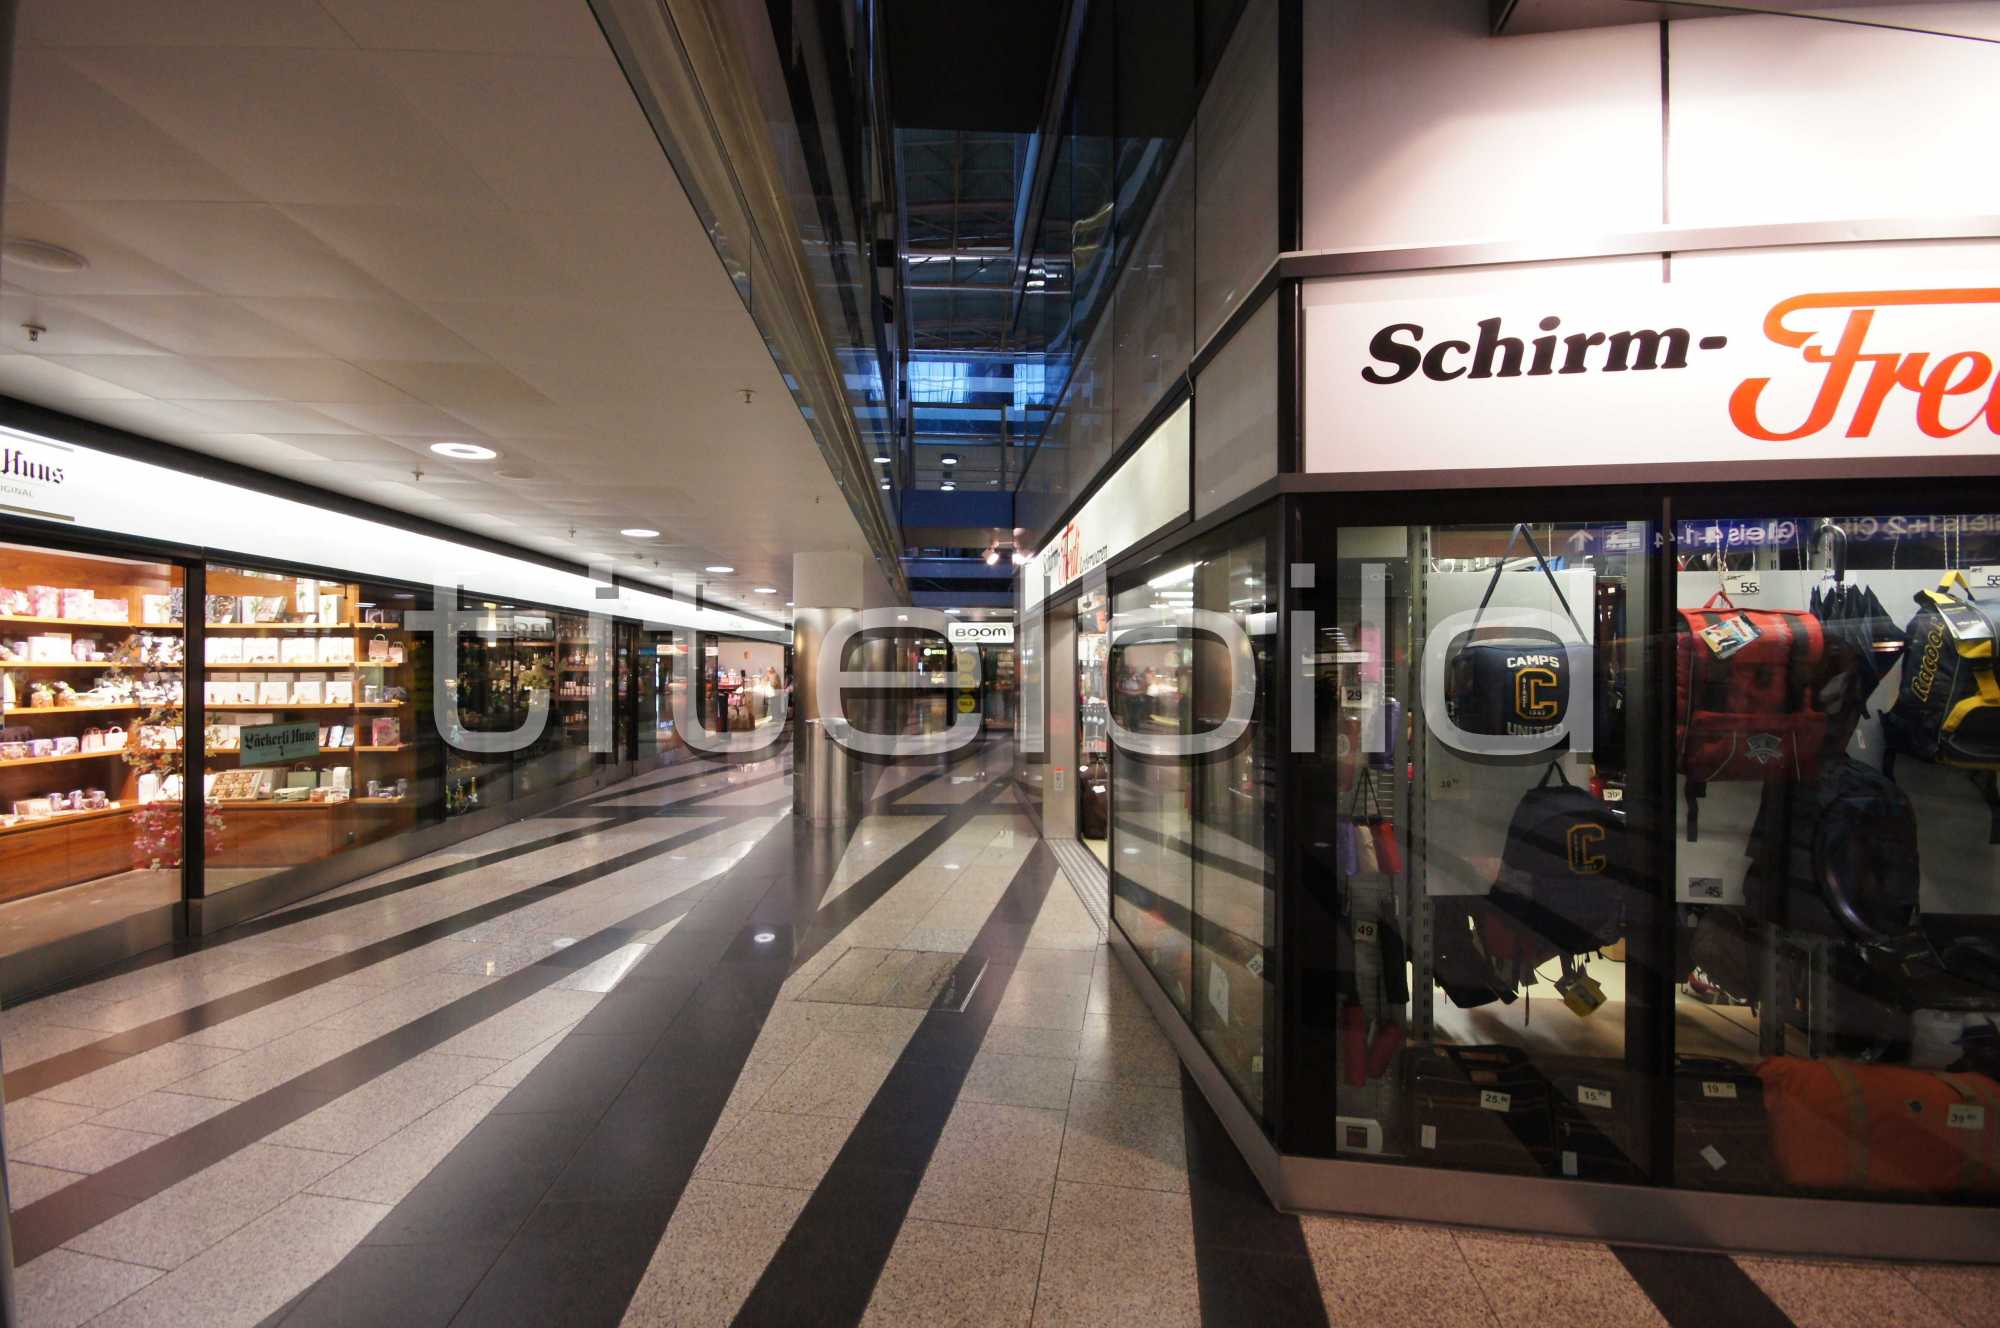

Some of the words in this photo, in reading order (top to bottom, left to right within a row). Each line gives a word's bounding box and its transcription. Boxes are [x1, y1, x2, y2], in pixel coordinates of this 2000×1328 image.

[1361, 316, 1728, 385] Schirm-
[1729, 287, 2000, 442] Fre
[955, 627, 1007, 637] BOOM
[1506, 655, 1560, 668] CAMPS
[1515, 667, 1558, 719] C
[1567, 823, 1606, 874] C
